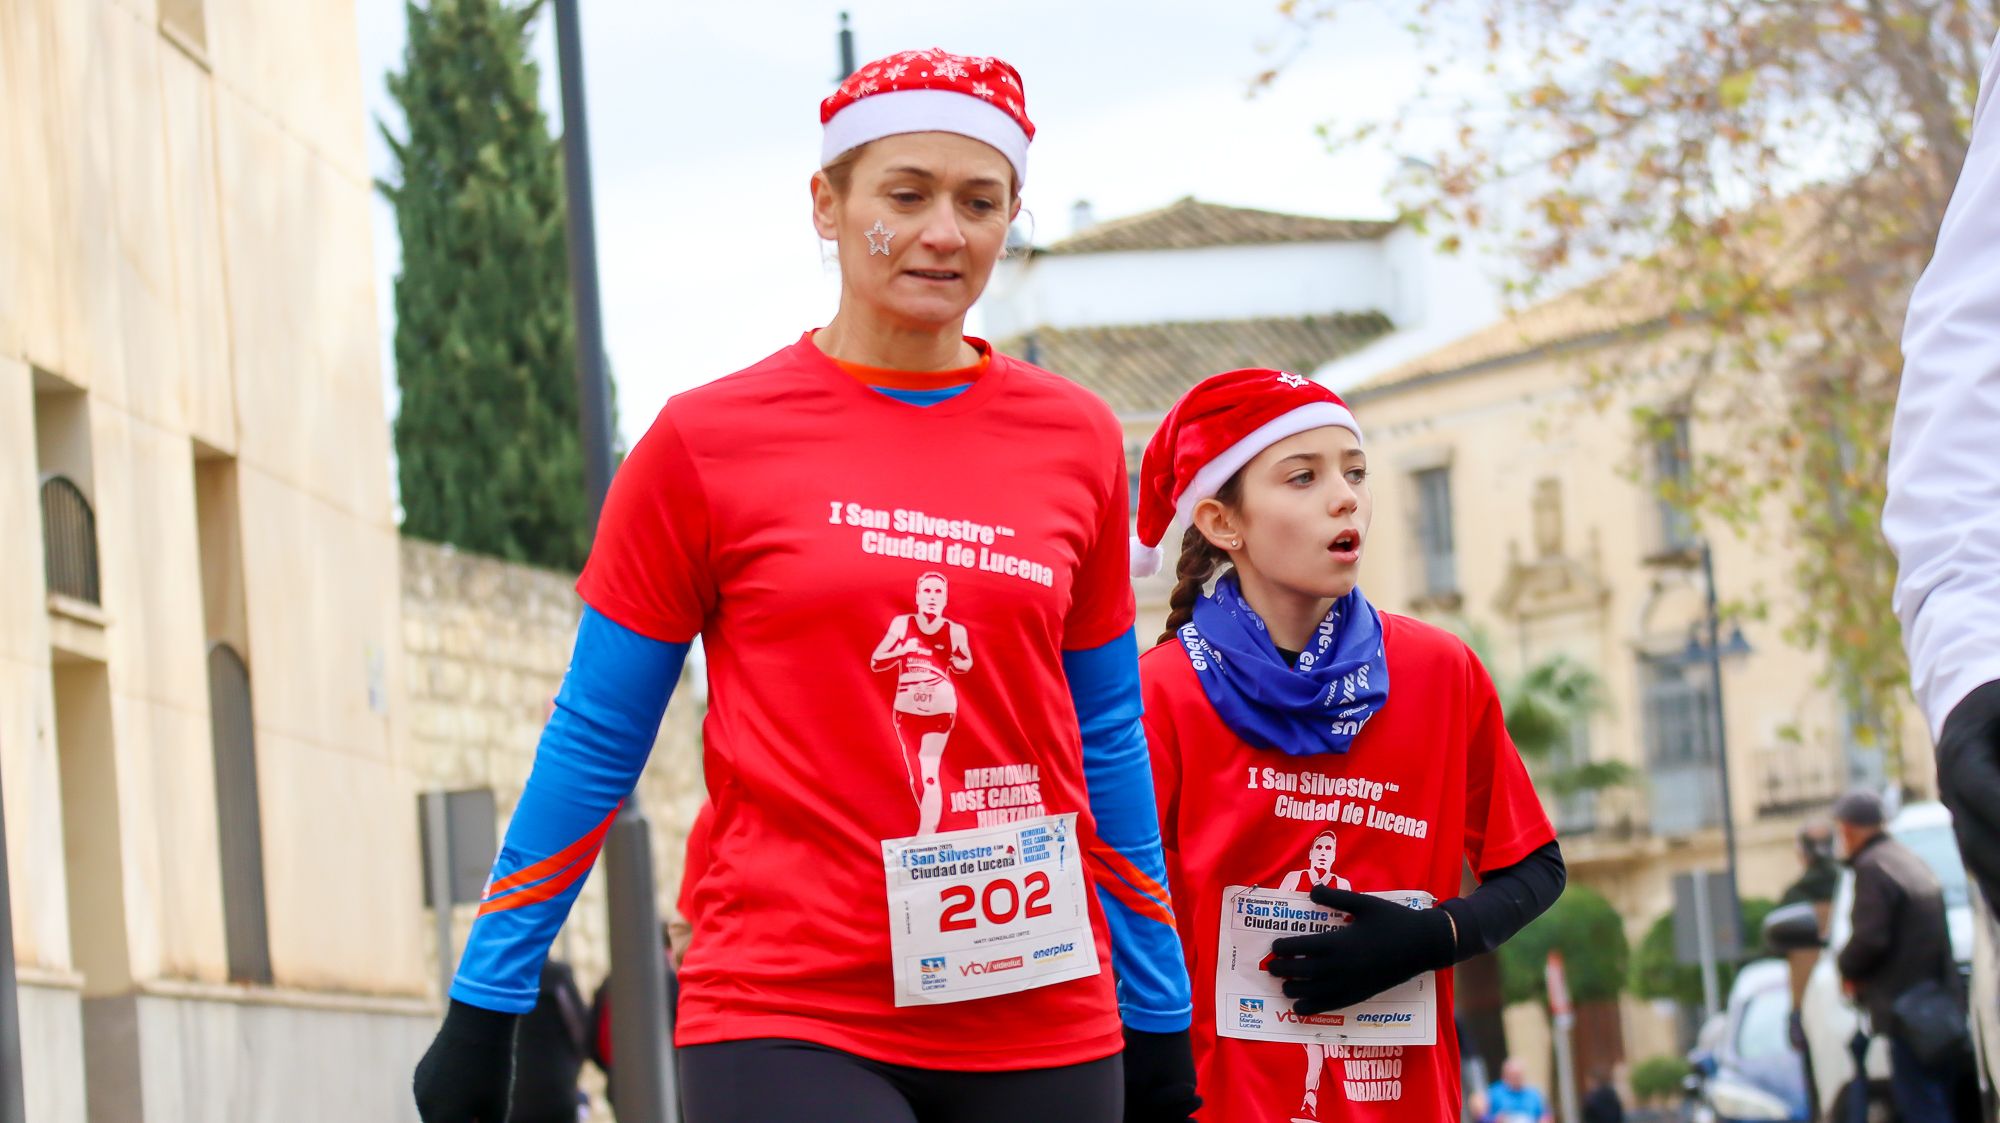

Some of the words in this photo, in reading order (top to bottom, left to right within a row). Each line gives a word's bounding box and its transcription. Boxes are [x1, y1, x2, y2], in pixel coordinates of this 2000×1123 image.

[829, 501, 842, 524] I
[845, 502, 890, 530] San
[893, 508, 995, 545] Silvestre
[861, 530, 943, 563] Ciudad
[945, 543, 976, 568] de
[978, 547, 1054, 588] Lucena
[913, 692, 933, 703] 001
[1248, 767, 1258, 789] I
[1262, 767, 1298, 792] San
[1300, 771, 1383, 801] Silvestre
[1384, 782, 1390, 791] 4
[950, 790, 986, 813] JOSE
[977, 804, 1045, 829] HURTADO
[1274, 795, 1340, 822] Ciudad
[1341, 802, 1364, 825] de
[1366, 805, 1428, 839] Lucena
[902, 854, 907, 867] I
[911, 853, 936, 867] San
[938, 846, 992, 864] Silvestre
[911, 865, 957, 881] Ciudad
[960, 862, 975, 875] de
[978, 857, 1015, 873] Lucena
[938, 870, 1052, 933] 202
[1236, 903, 1244, 914] I
[1246, 903, 1270, 916] San
[1272, 907, 1329, 921] Silvestre
[1245, 898, 1273, 906] diciembre
[1244, 916, 1288, 931] Ciudad
[1291, 921, 1307, 932] de
[1309, 922, 1345, 933] Luce
[1032, 943, 1074, 960] enerplus
[1310, 1016, 1342, 1024] videoluc
[1356, 1012, 1412, 1024] enerplus
[1322, 1043, 1351, 1059] JOSE
[1353, 1044, 1404, 1058] CARLOS
[1343, 1059, 1403, 1080] HURTADO
